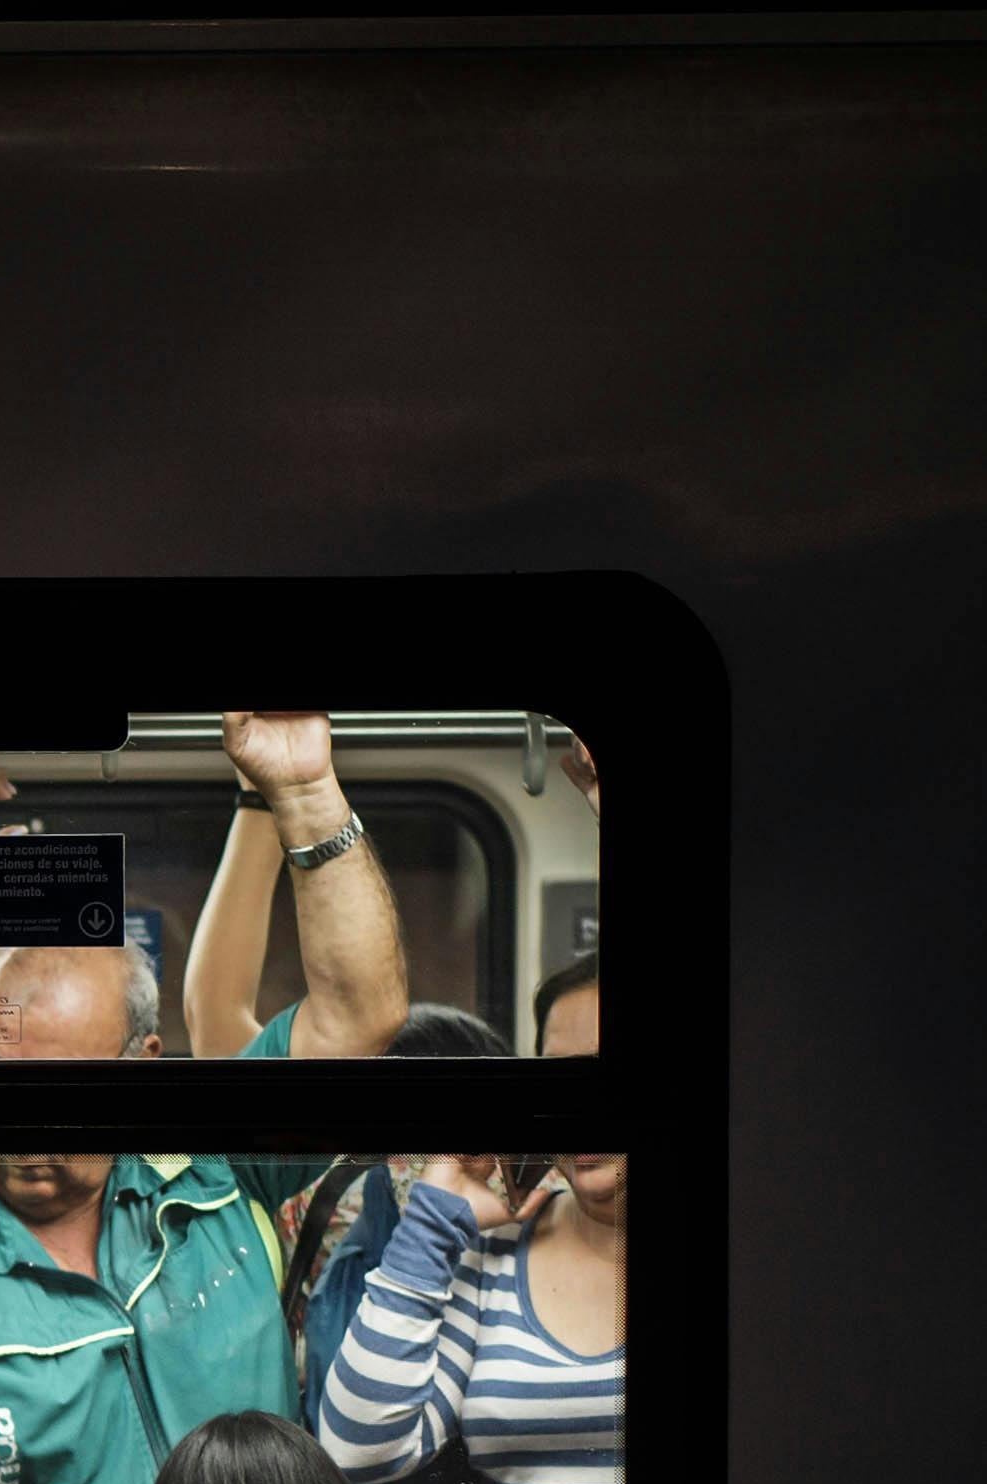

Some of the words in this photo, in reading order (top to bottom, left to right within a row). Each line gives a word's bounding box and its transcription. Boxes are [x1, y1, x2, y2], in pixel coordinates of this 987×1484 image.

[14, 843, 99, 856] acondicionado
[37, 857, 52, 870] de
[54, 859, 70, 870] su
[72, 857, 103, 871] viaje.
[3, 871, 55, 884] cerradas
[57, 871, 110, 883] mientras
